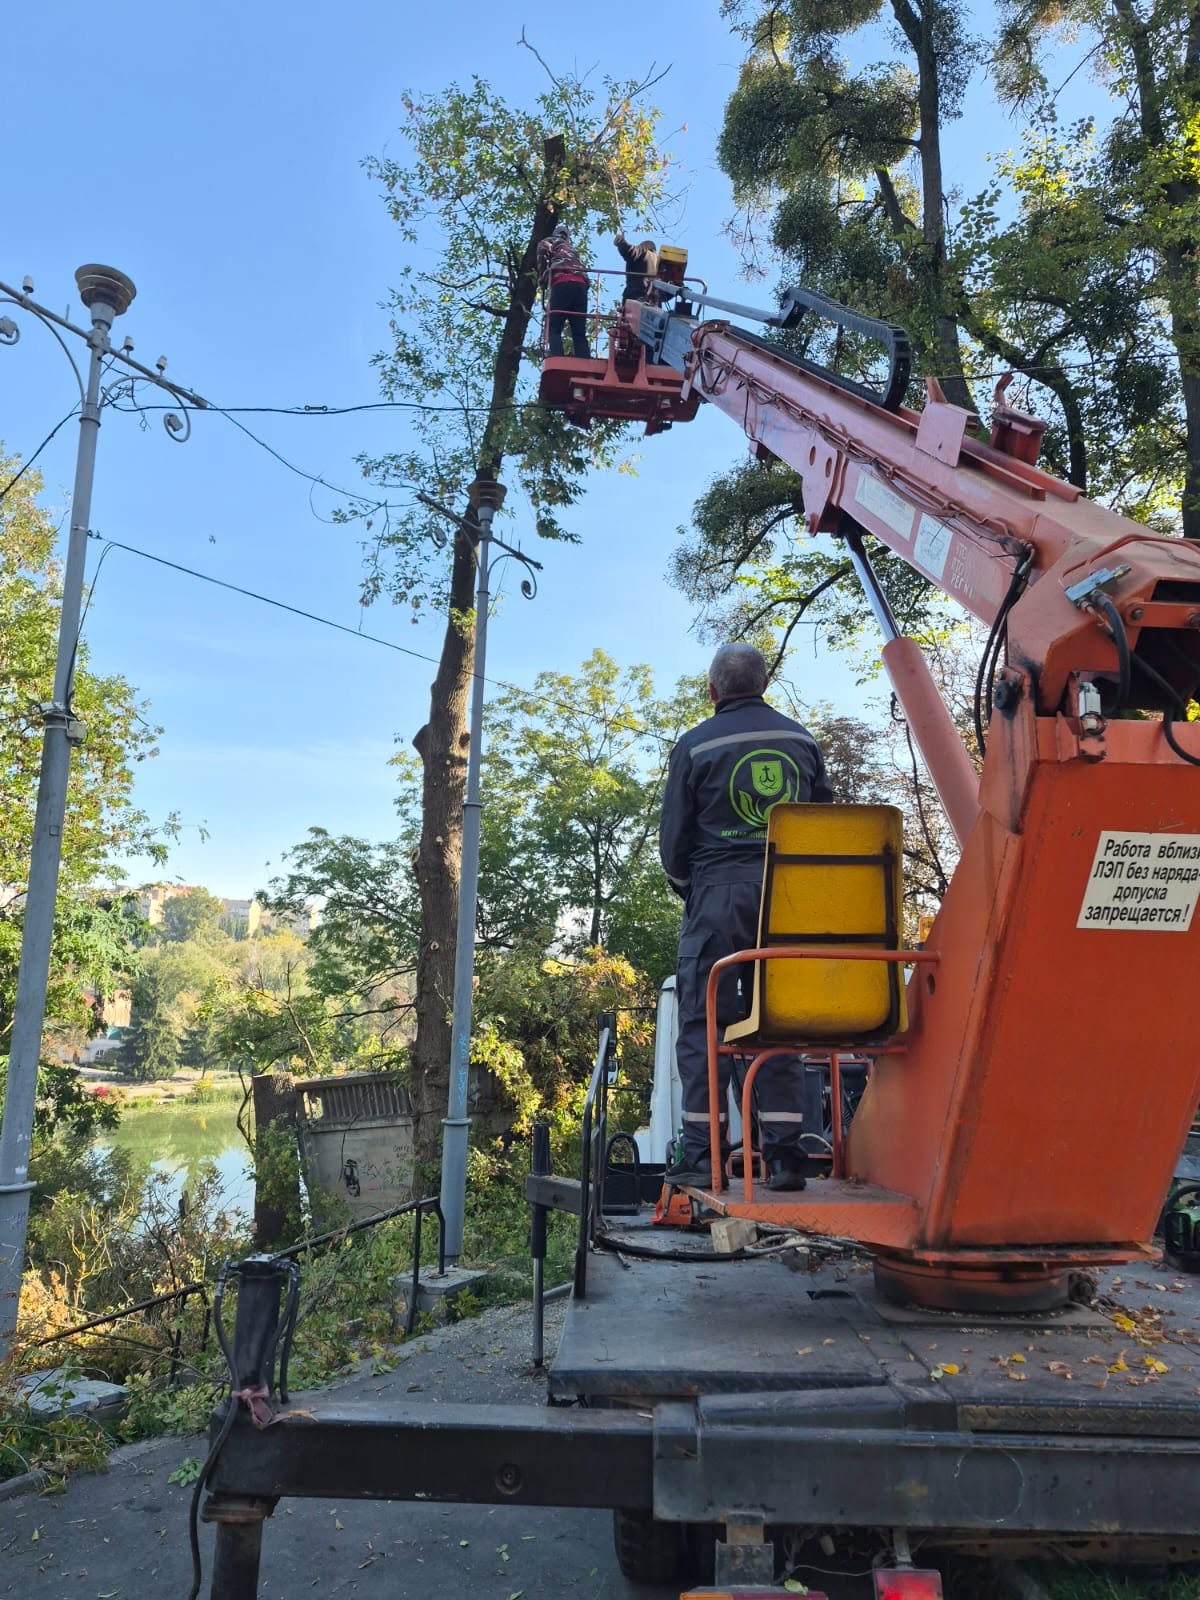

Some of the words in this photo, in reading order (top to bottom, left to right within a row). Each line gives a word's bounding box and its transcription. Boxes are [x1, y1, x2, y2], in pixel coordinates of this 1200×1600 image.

[1103, 839, 1151, 858] Работа
[1093, 861, 1124, 878] ЛЭП
[1126, 862, 1149, 880] без
[1112, 886, 1168, 904] допуска
[1085, 904, 1190, 925] запрещается!
